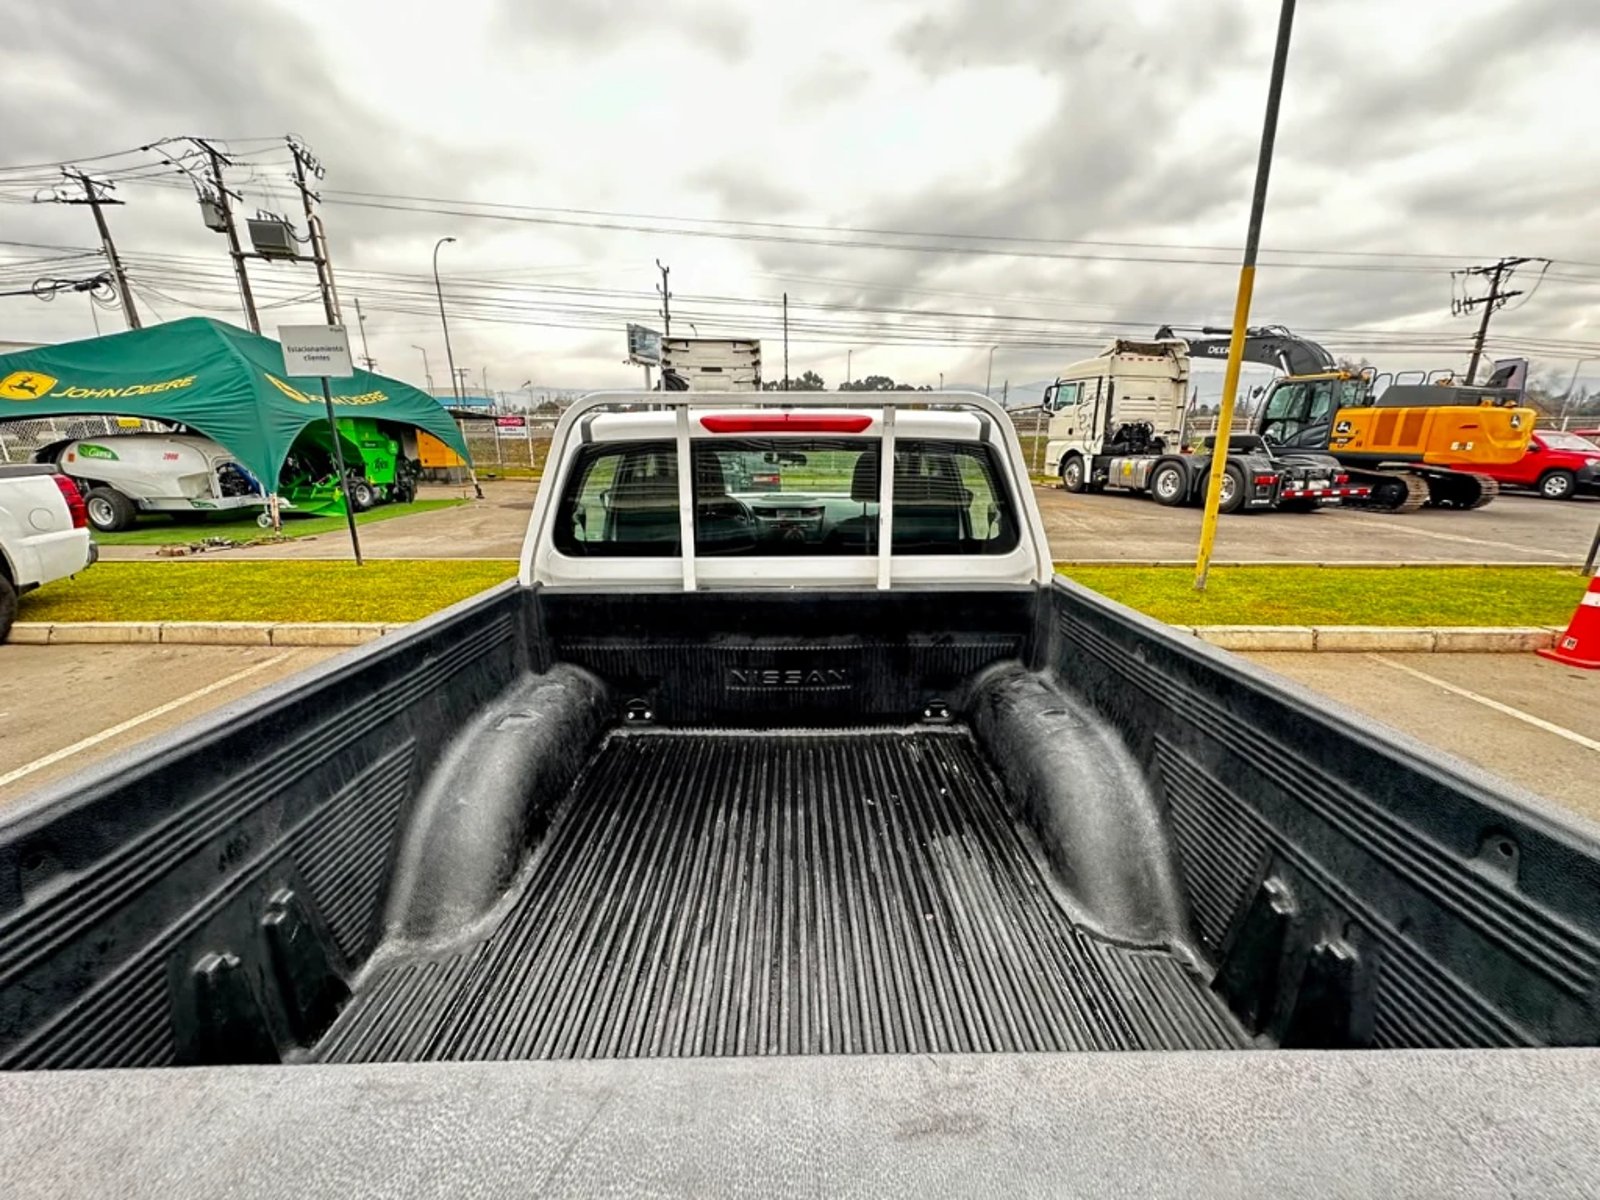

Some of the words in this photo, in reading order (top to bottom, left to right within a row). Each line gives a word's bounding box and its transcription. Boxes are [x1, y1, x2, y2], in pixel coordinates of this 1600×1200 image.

[287, 345, 344, 353] Estacionamiento
[1207, 345, 1230, 354] DEER
[50, 386, 123, 398] JOHN
[120, 375, 198, 396] DEERE
[730, 669, 846, 684] NISSAN
